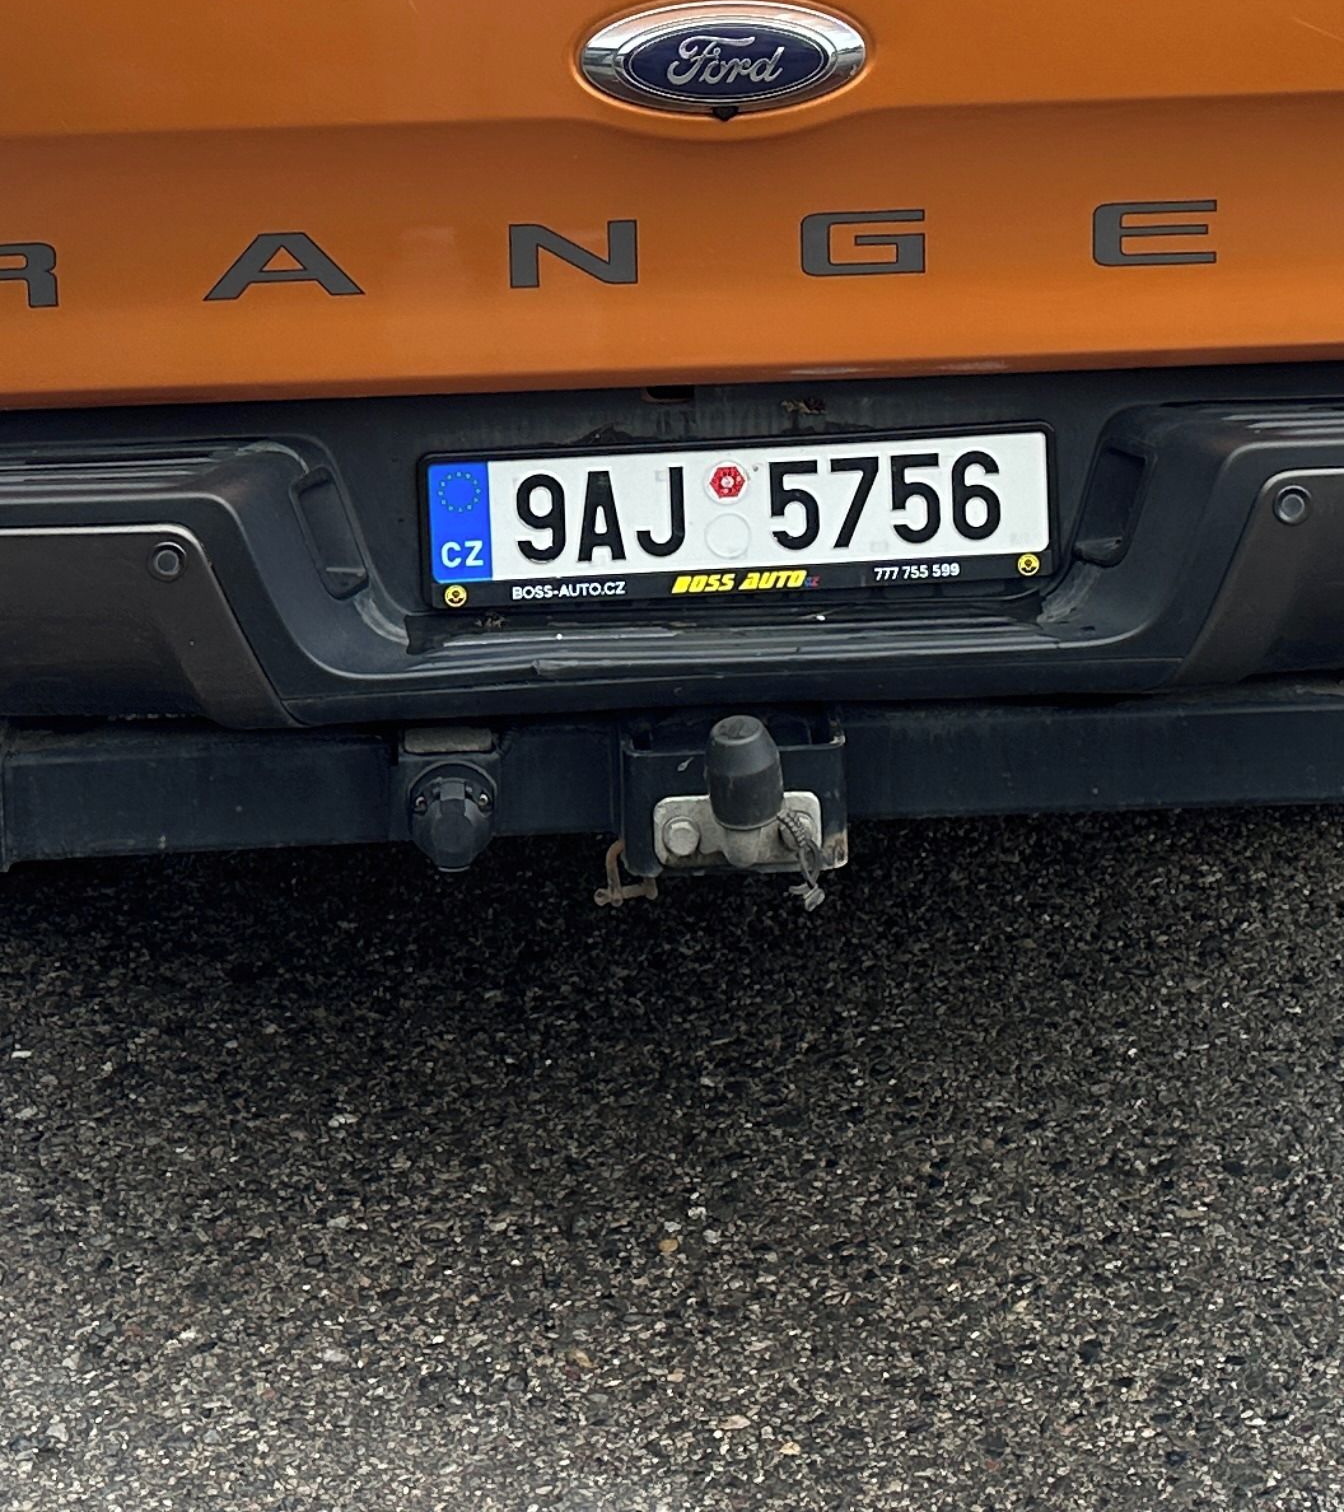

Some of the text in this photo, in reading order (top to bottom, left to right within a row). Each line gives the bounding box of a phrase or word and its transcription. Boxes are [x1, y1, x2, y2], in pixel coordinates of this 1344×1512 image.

[667, 35, 785, 86] Ford
[515, 450, 1001, 563] 9AJ 5756
[441, 540, 484, 569] CZ
[671, 573, 736, 594] BOSS
[738, 570, 808, 590] AUTO
[874, 563, 960, 581] 777 755 599
[512, 581, 626, 600] BOSS-AUTO.CZ
